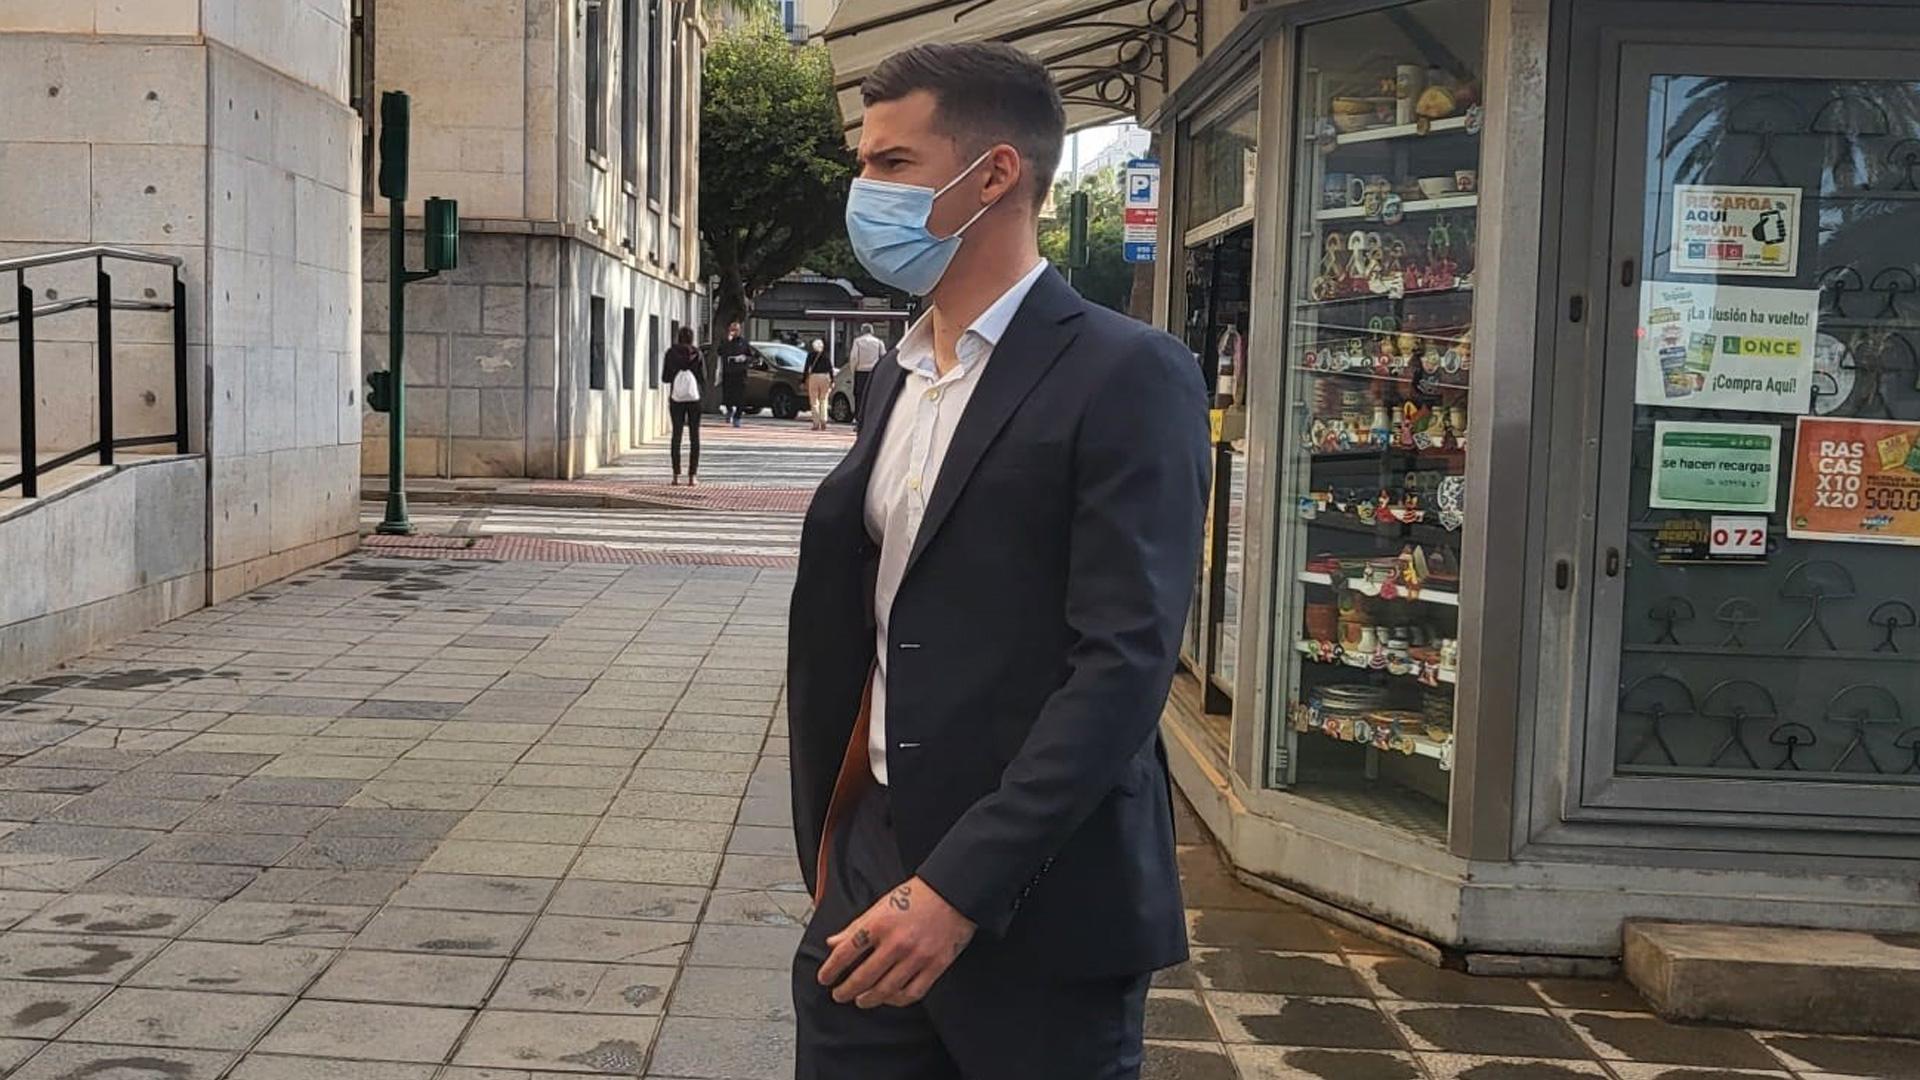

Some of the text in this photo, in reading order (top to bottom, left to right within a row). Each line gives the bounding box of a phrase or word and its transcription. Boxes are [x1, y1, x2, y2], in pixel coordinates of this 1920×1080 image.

[1131, 175, 1149, 195] P
[1686, 194, 1773, 210] RECARGA
[1687, 305, 1705, 322] ¡La
[1750, 309, 1764, 323] ha
[1768, 311, 1809, 326] vuelto!
[1744, 340, 1797, 355] ONCE
[1712, 374, 1797, 396] ¡Compra Aquí!
[1820, 441, 1865, 458] RAS
[1662, 458, 1771, 474] se hacen recargas
[1818, 458, 1862, 475] CAS
[1816, 474, 1860, 492] X10
[1815, 491, 1859, 508] X20
